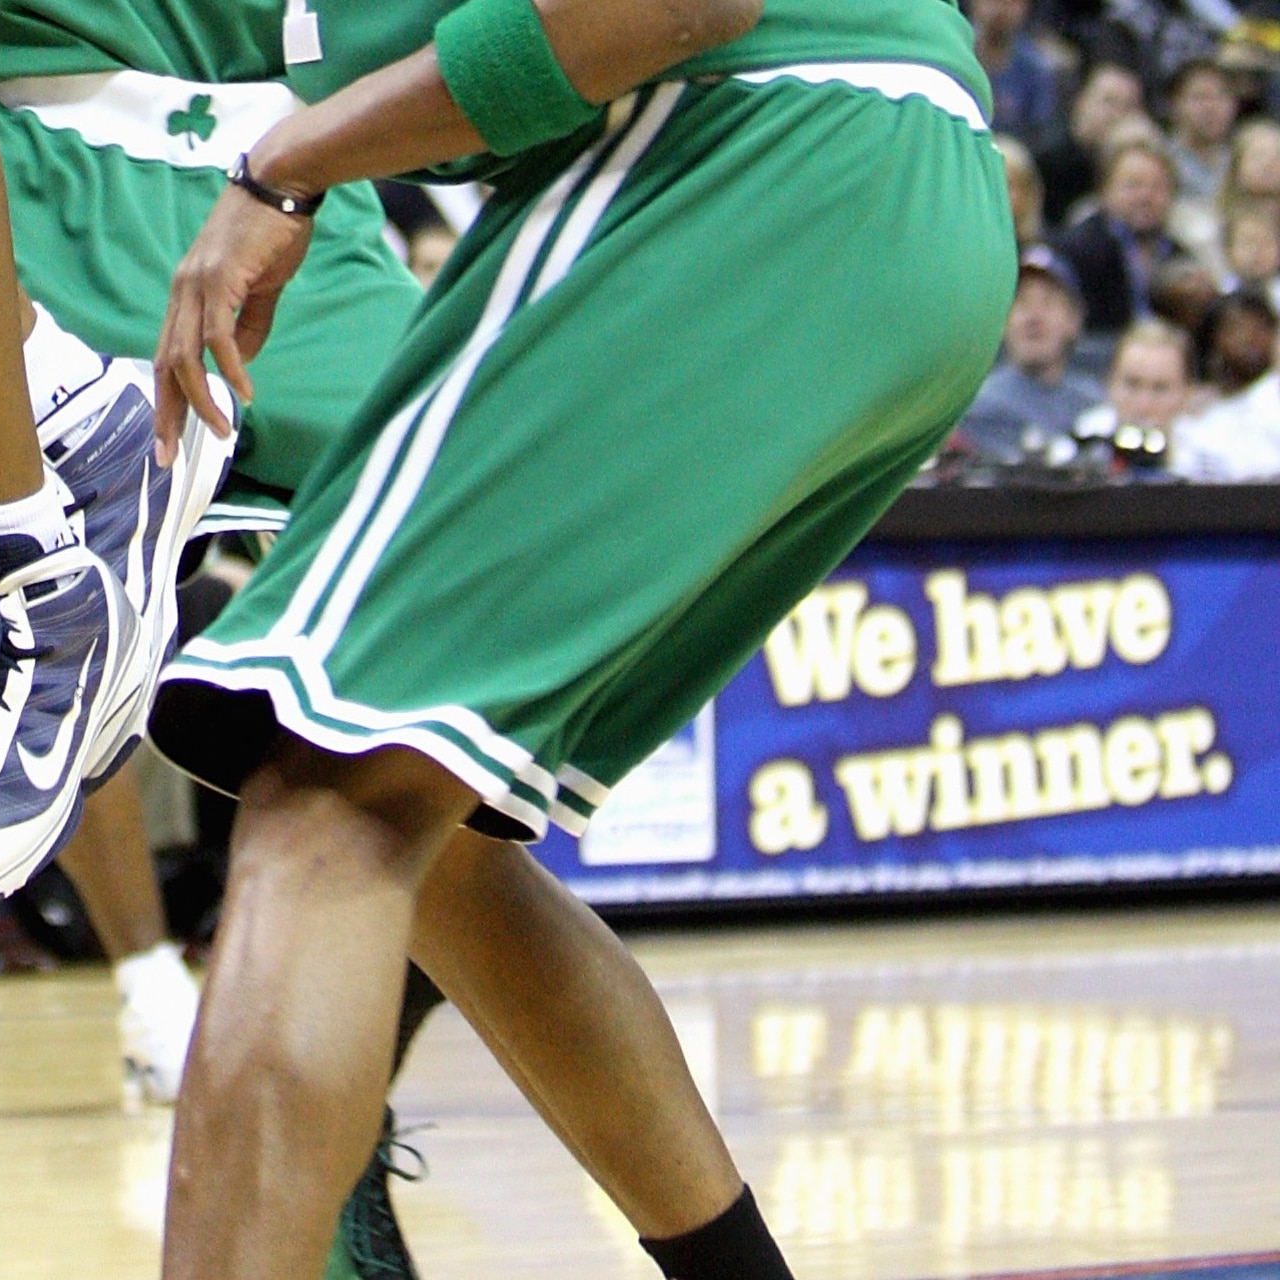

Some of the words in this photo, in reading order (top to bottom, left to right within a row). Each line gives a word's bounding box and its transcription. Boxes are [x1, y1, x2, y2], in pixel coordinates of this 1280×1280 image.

[765, 582, 917, 707] We
[925, 568, 1172, 687] have
[748, 758, 829, 855] a
[835, 706, 1234, 843] winner.
